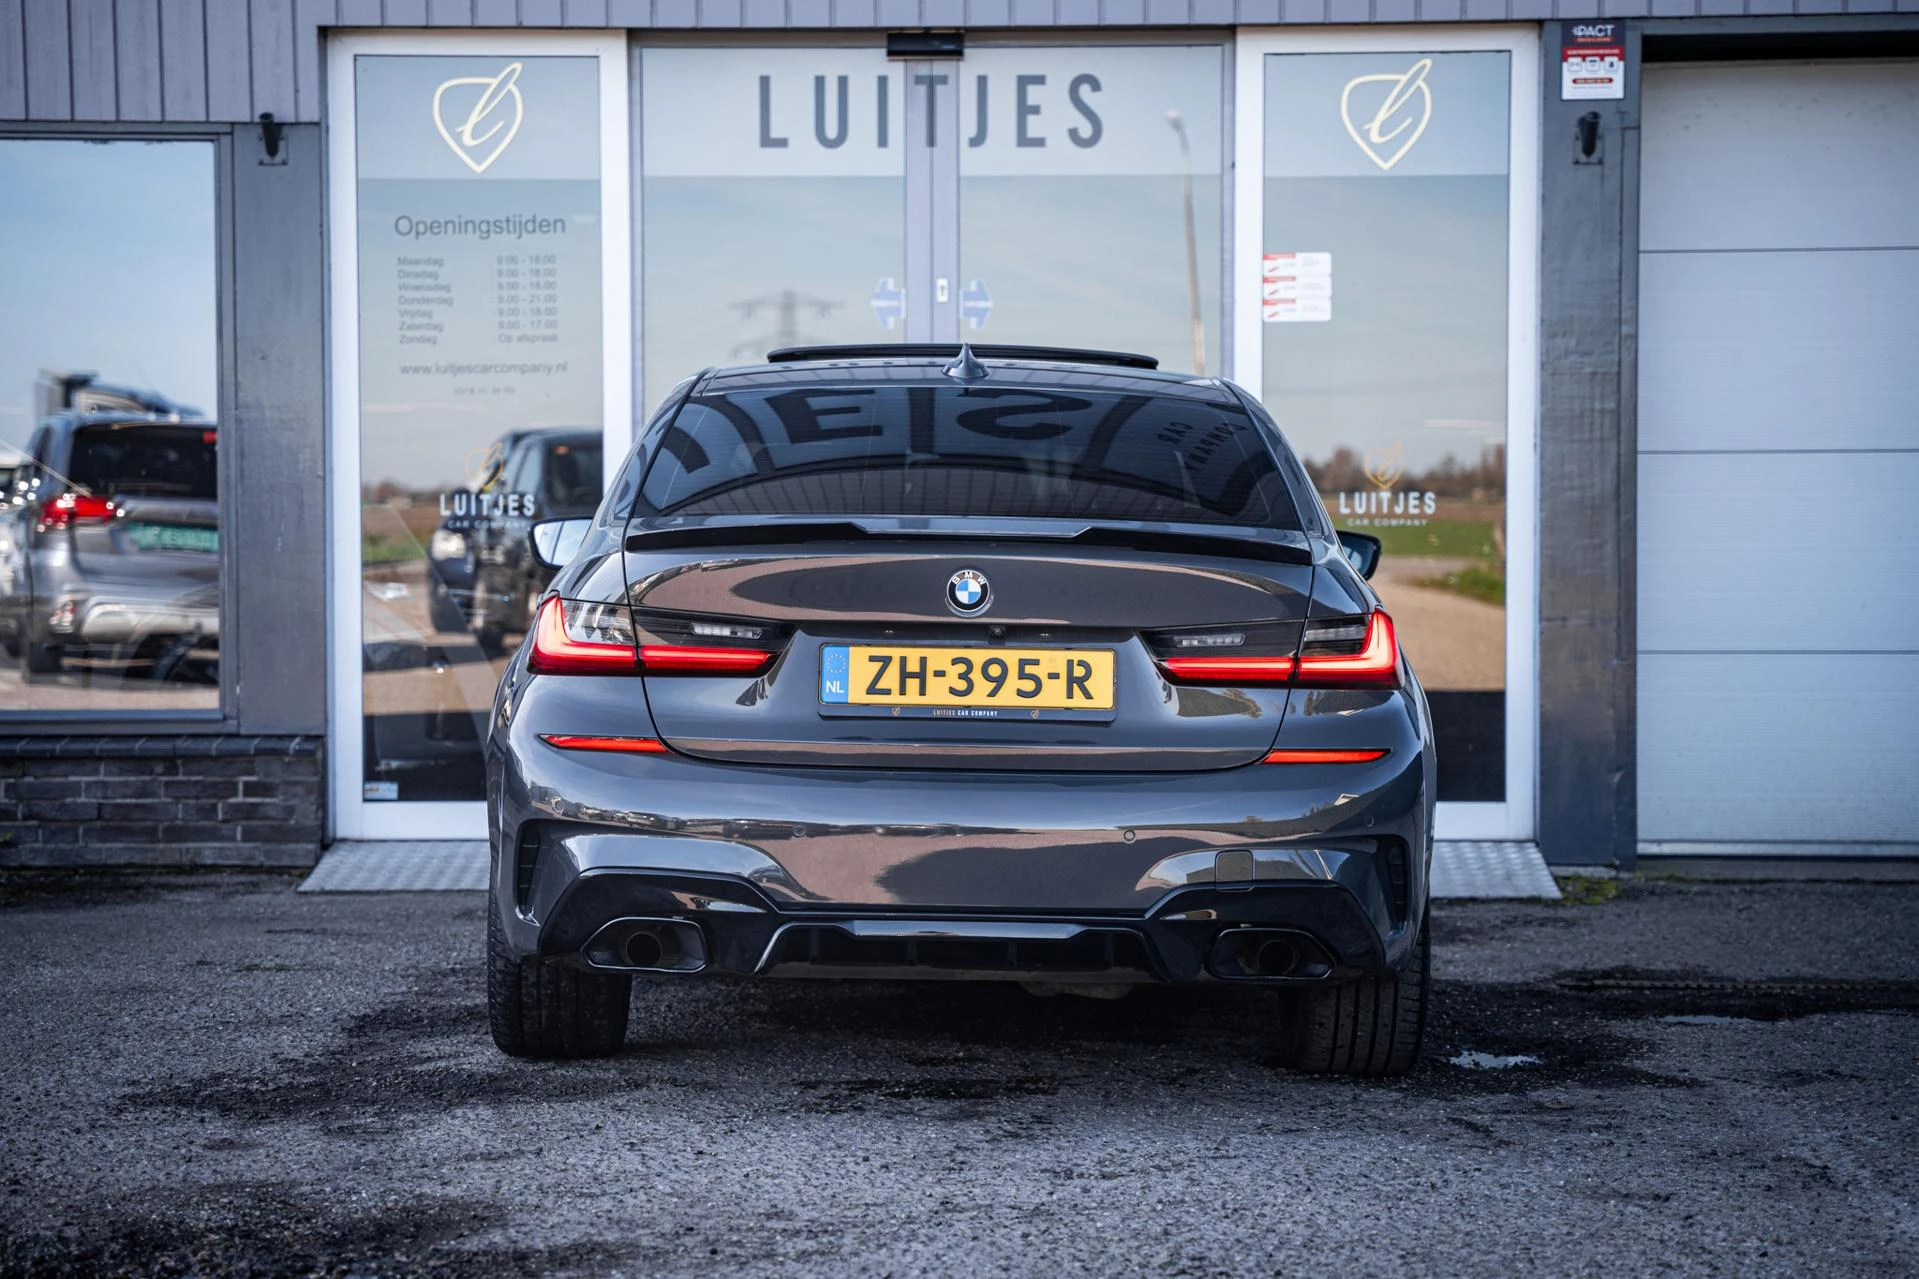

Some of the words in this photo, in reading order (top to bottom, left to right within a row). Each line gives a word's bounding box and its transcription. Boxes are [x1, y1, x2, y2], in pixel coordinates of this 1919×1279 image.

[758, 73, 1104, 149] LUITJES
[394, 214, 566, 240] Openingstijden
[397, 257, 445, 268] Maandag
[440, 493, 536, 516] LUITJES
[1338, 491, 1437, 515] LUITJES
[950, 571, 987, 586] BMW
[825, 680, 845, 693] NL
[865, 655, 1094, 700] ZH-395-R
[957, 709, 970, 717] CAR
[971, 709, 998, 717] COMPANY
